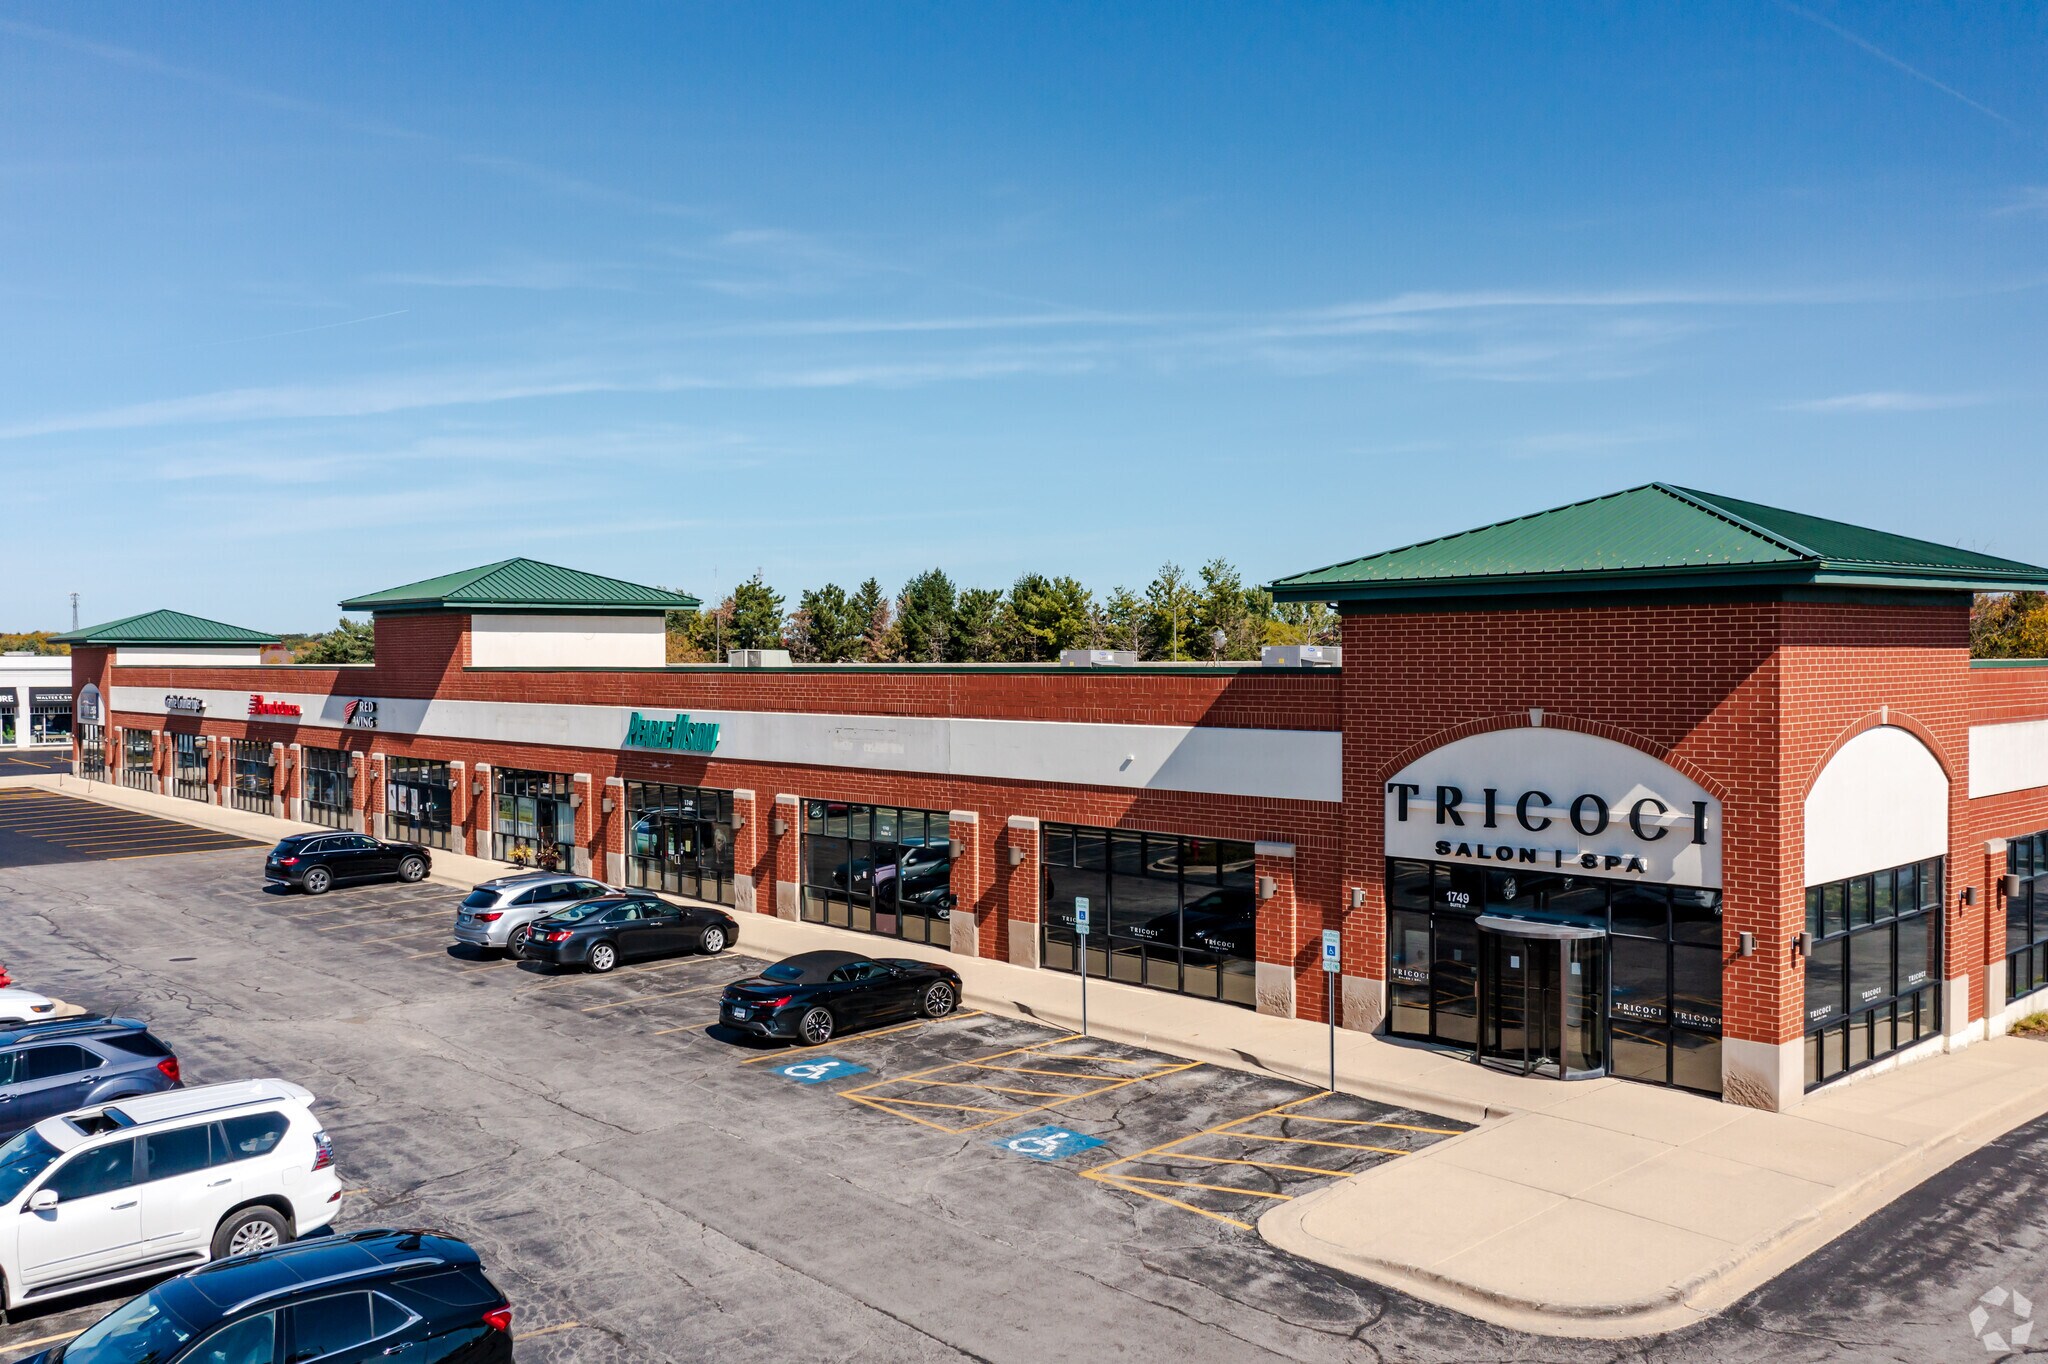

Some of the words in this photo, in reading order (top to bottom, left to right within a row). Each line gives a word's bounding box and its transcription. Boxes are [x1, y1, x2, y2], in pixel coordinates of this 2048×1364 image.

[359, 701, 375, 712] RED
[626, 712, 673, 749] PEARLE
[671, 714, 719, 752] VISION
[1388, 782, 1708, 845] TRICOCI
[1434, 840, 1537, 864] SALON
[1580, 853, 1646, 874] SPA
[1446, 890, 1470, 904] 1749
[1130, 926, 1158, 937] TRICOCI
[1204, 938, 1235, 949] TRICOCI
[1392, 967, 1429, 980] TRICOCI
[1616, 1002, 1662, 1016] TRICOCI
[1673, 1011, 1722, 1025] TRICOCI
